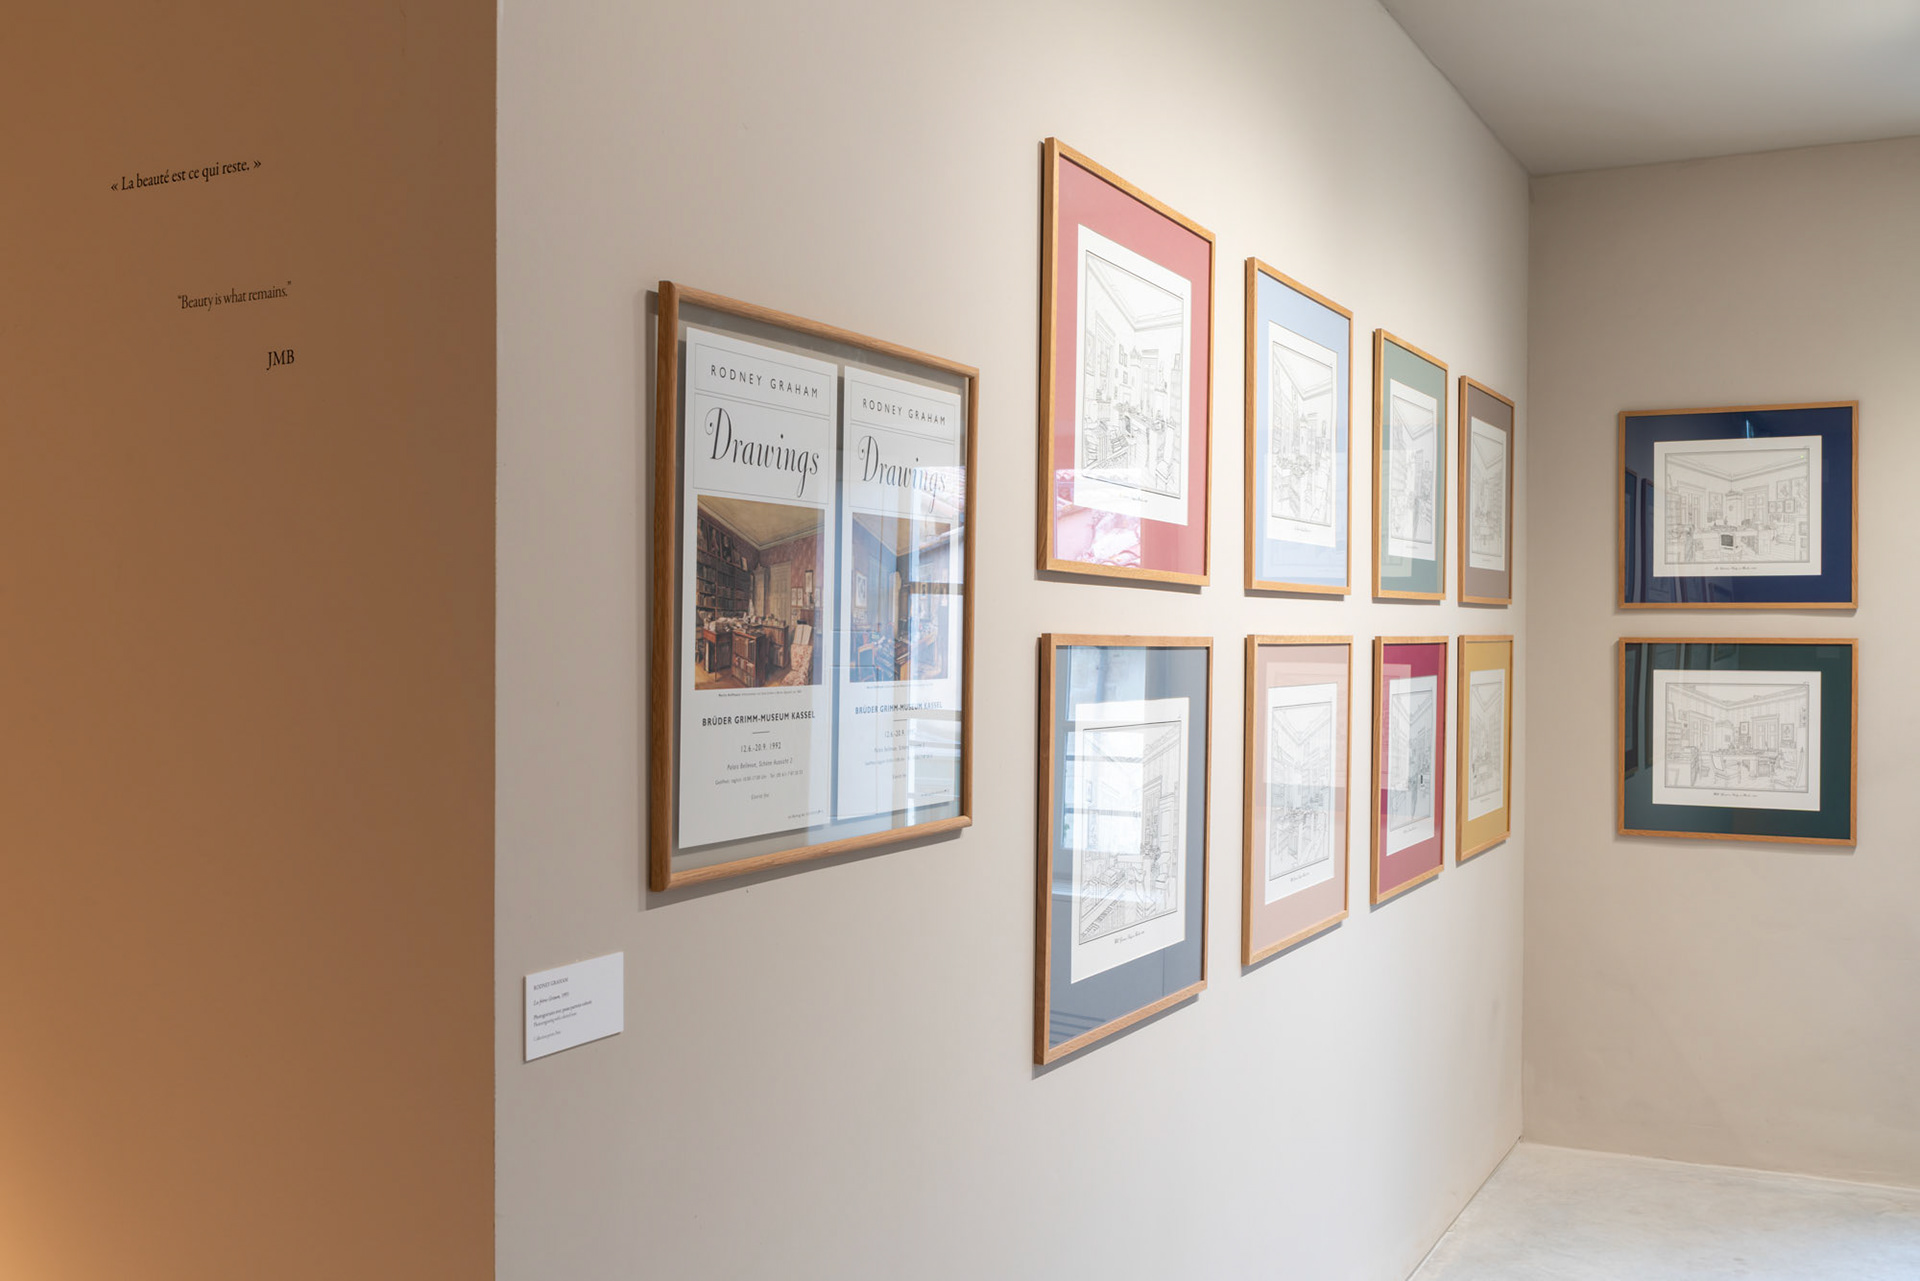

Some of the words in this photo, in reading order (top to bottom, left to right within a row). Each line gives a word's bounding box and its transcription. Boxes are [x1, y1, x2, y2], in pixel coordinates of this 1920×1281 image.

[121, 176, 134, 191] La
[136, 169, 170, 188] beauté
[171, 171, 186, 183] est
[188, 168, 200, 179] ce
[202, 161, 219, 182] qui
[222, 160, 250, 174] reste.
[215, 294, 222, 305] is
[223, 288, 247, 304] what
[266, 349, 295, 370] JMB
[711, 364, 763, 386] RODNEY
[770, 378, 819, 398] GRAHAM
[862, 398, 903, 416] RODNEY
[908, 408, 946, 425] GRAHAM
[704, 406, 820, 498] Drawings
[857, 435, 946, 514] Drawings
[702, 715, 732, 727] BRÜDER
[734, 712, 790, 724] GRIMM-MUSEUM
[791, 710, 816, 720] KASSEL
[855, 705, 878, 714] BRÜDER
[924, 701, 943, 710] KASSEL
